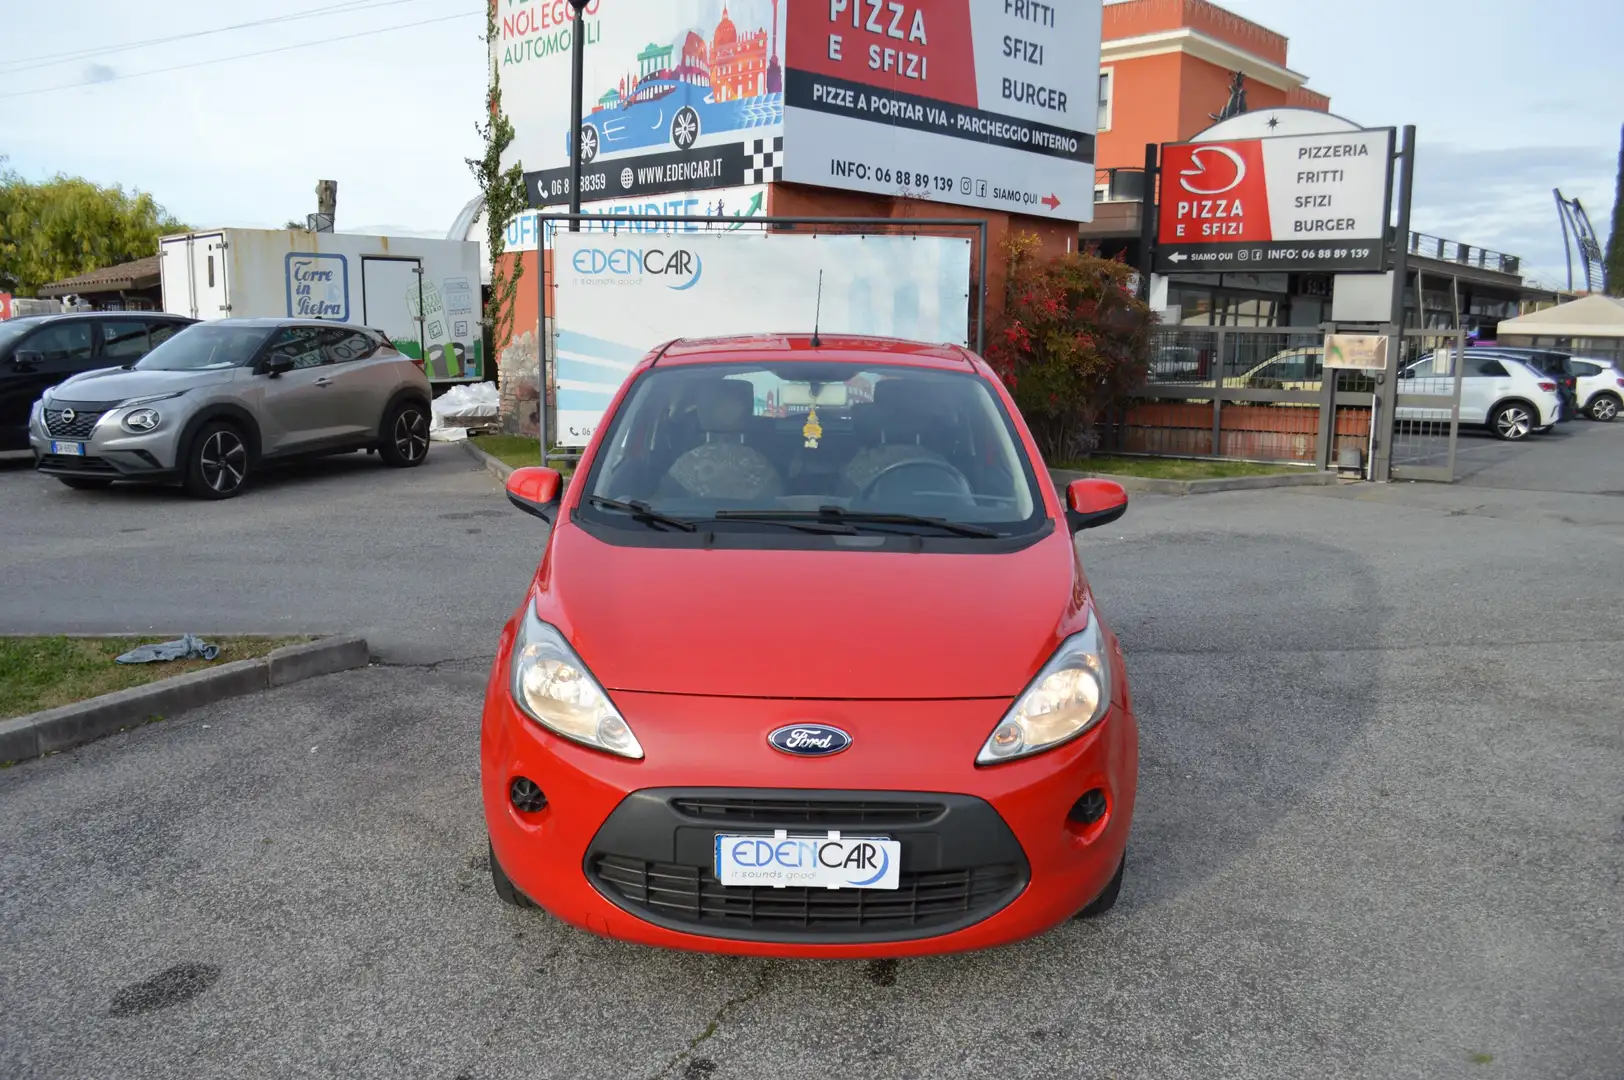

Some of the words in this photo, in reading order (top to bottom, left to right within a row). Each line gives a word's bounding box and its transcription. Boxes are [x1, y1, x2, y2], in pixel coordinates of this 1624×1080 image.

[830, 0, 927, 45] PIZZA
[1004, 0, 1055, 29] FRITTI
[503, 19, 600, 66] AUTOMOLI
[1002, 34, 1044, 66] SFIZI
[829, 33, 843, 61] E
[868, 43, 927, 80] SFIZI
[1002, 76, 1068, 113] BURGER
[813, 83, 854, 108] PIZZE
[857, 93, 868, 111] A
[870, 95, 924, 122] PORTAR
[926, 106, 949, 127] VIA
[957, 113, 1030, 143] PARCHEGGIO
[1031, 129, 1078, 153] INTERNO
[1298, 144, 1369, 160] PIZZERIA
[551, 179, 563, 196] 06
[637, 157, 724, 186] WWW.EDENCAR.IT
[830, 158, 872, 181] INFO:
[875, 166, 892, 184] 06
[895, 170, 911, 187] 88
[914, 173, 930, 189] 89
[932, 176, 954, 193] 139
[992, 186, 1021, 204] SIAMO
[1022, 193, 1039, 206] QUI
[1297, 170, 1344, 184] FRITTI
[1177, 199, 1244, 219] PIZZA
[1294, 194, 1332, 209] SFIZI
[1176, 224, 1186, 237] E
[1201, 222, 1244, 236] SFIZI
[1293, 218, 1356, 233] BURGER
[572, 248, 693, 275] EDENCAR
[1190, 253, 1215, 261] SIAMO
[1218, 253, 1234, 261] QUI
[1267, 249, 1299, 260] INFO:
[1301, 250, 1315, 259] 06
[1317, 249, 1331, 259] 88
[1333, 249, 1347, 259] 89
[1350, 248, 1370, 258] 139
[294, 260, 334, 282] Torre
[295, 281, 311, 296] in
[297, 295, 341, 316] Pietra
[786, 728, 833, 749] Ford
[732, 840, 878, 870] EDENCAR
